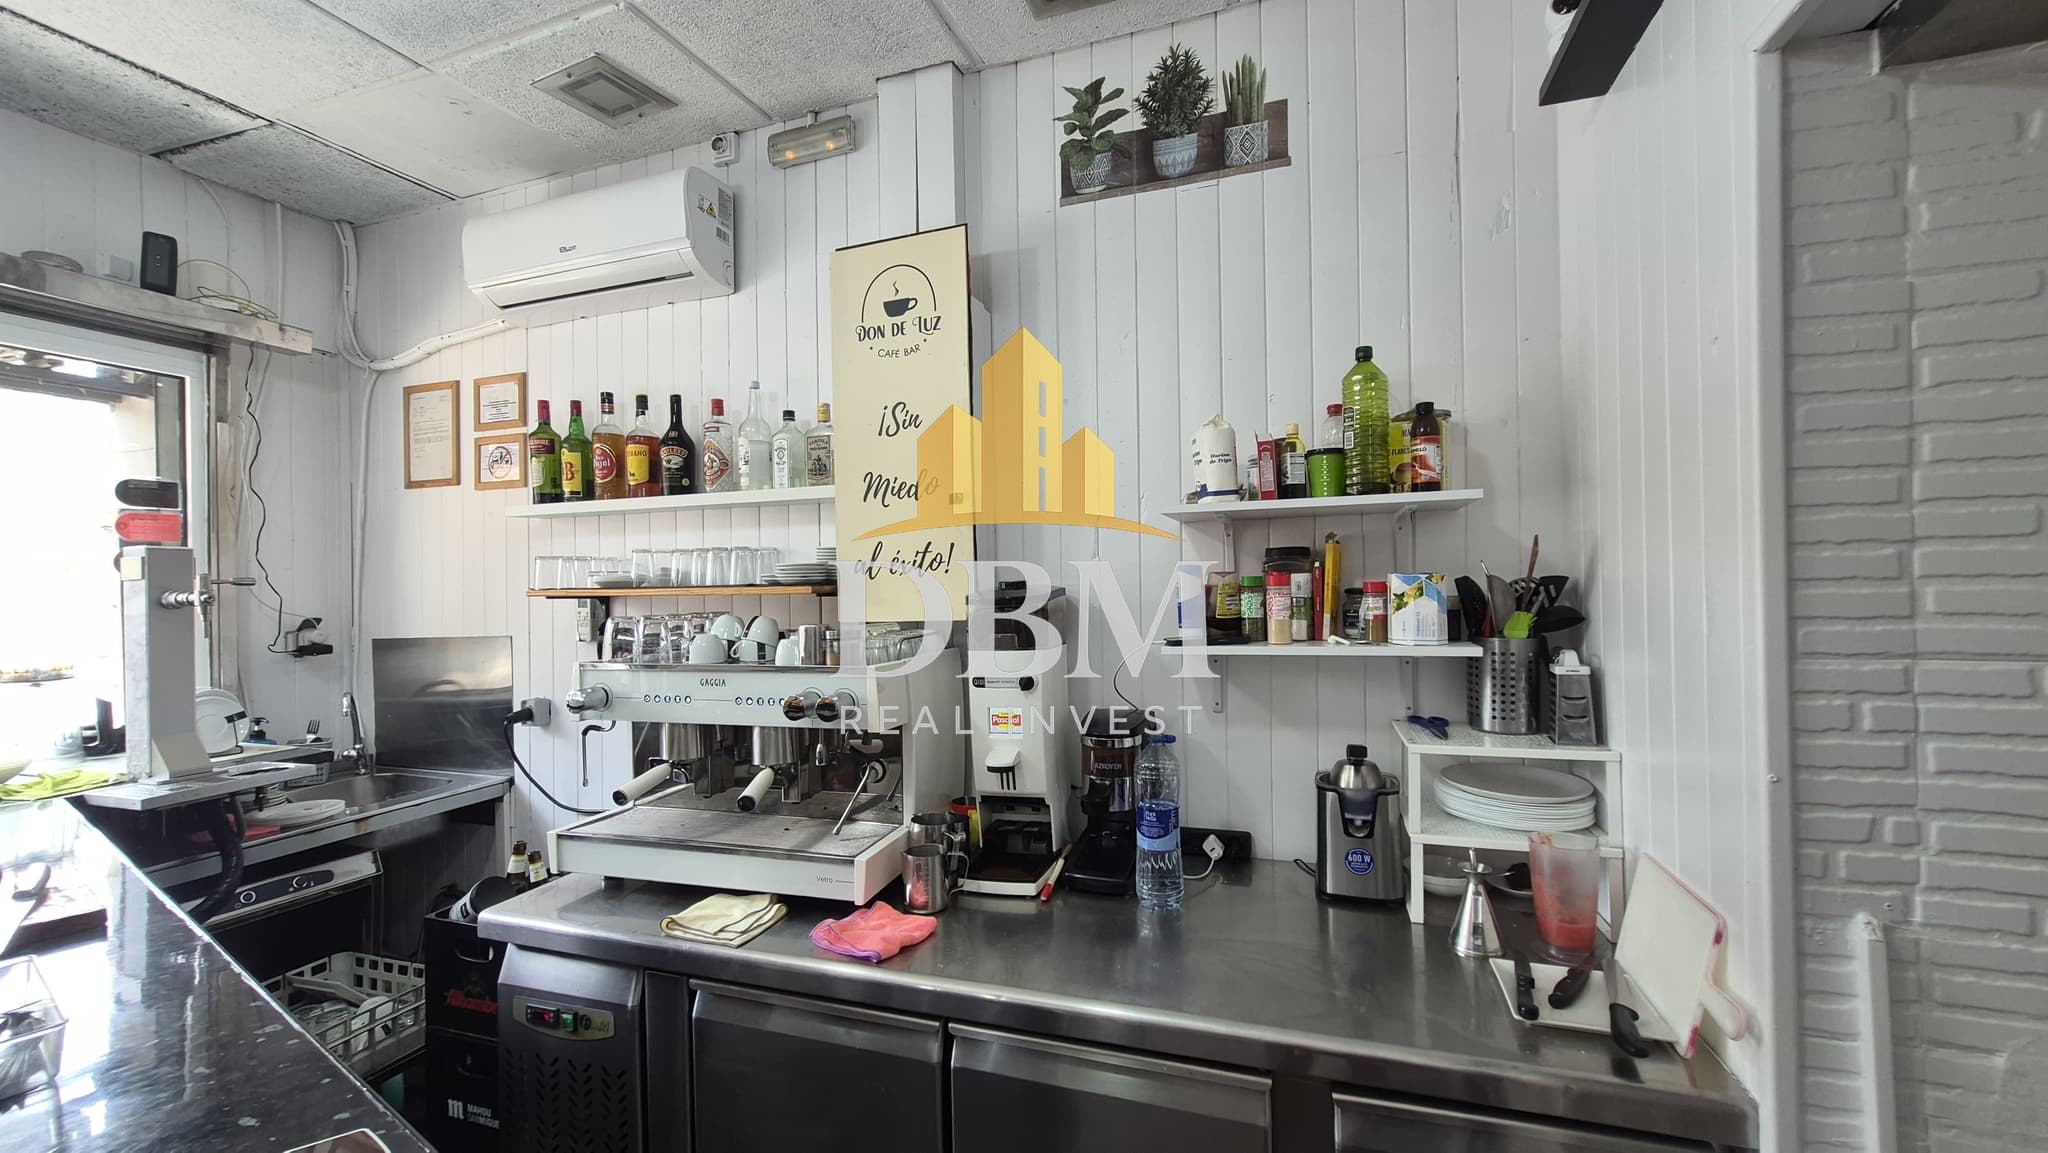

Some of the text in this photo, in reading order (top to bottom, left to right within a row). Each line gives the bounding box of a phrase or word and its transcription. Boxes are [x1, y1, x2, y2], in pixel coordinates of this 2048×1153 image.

[856, 315, 942, 342] DON DE LUZ
[903, 343, 921, 357] BAR
[878, 401, 923, 437] ¡Sin
[863, 469, 940, 507] Miedo
[855, 541, 955, 580] al éxito!
[700, 678, 727, 687] GAGGIA
[1348, 853, 1371, 863] 600 W
[467, 1103, 491, 1118] MAHOU
